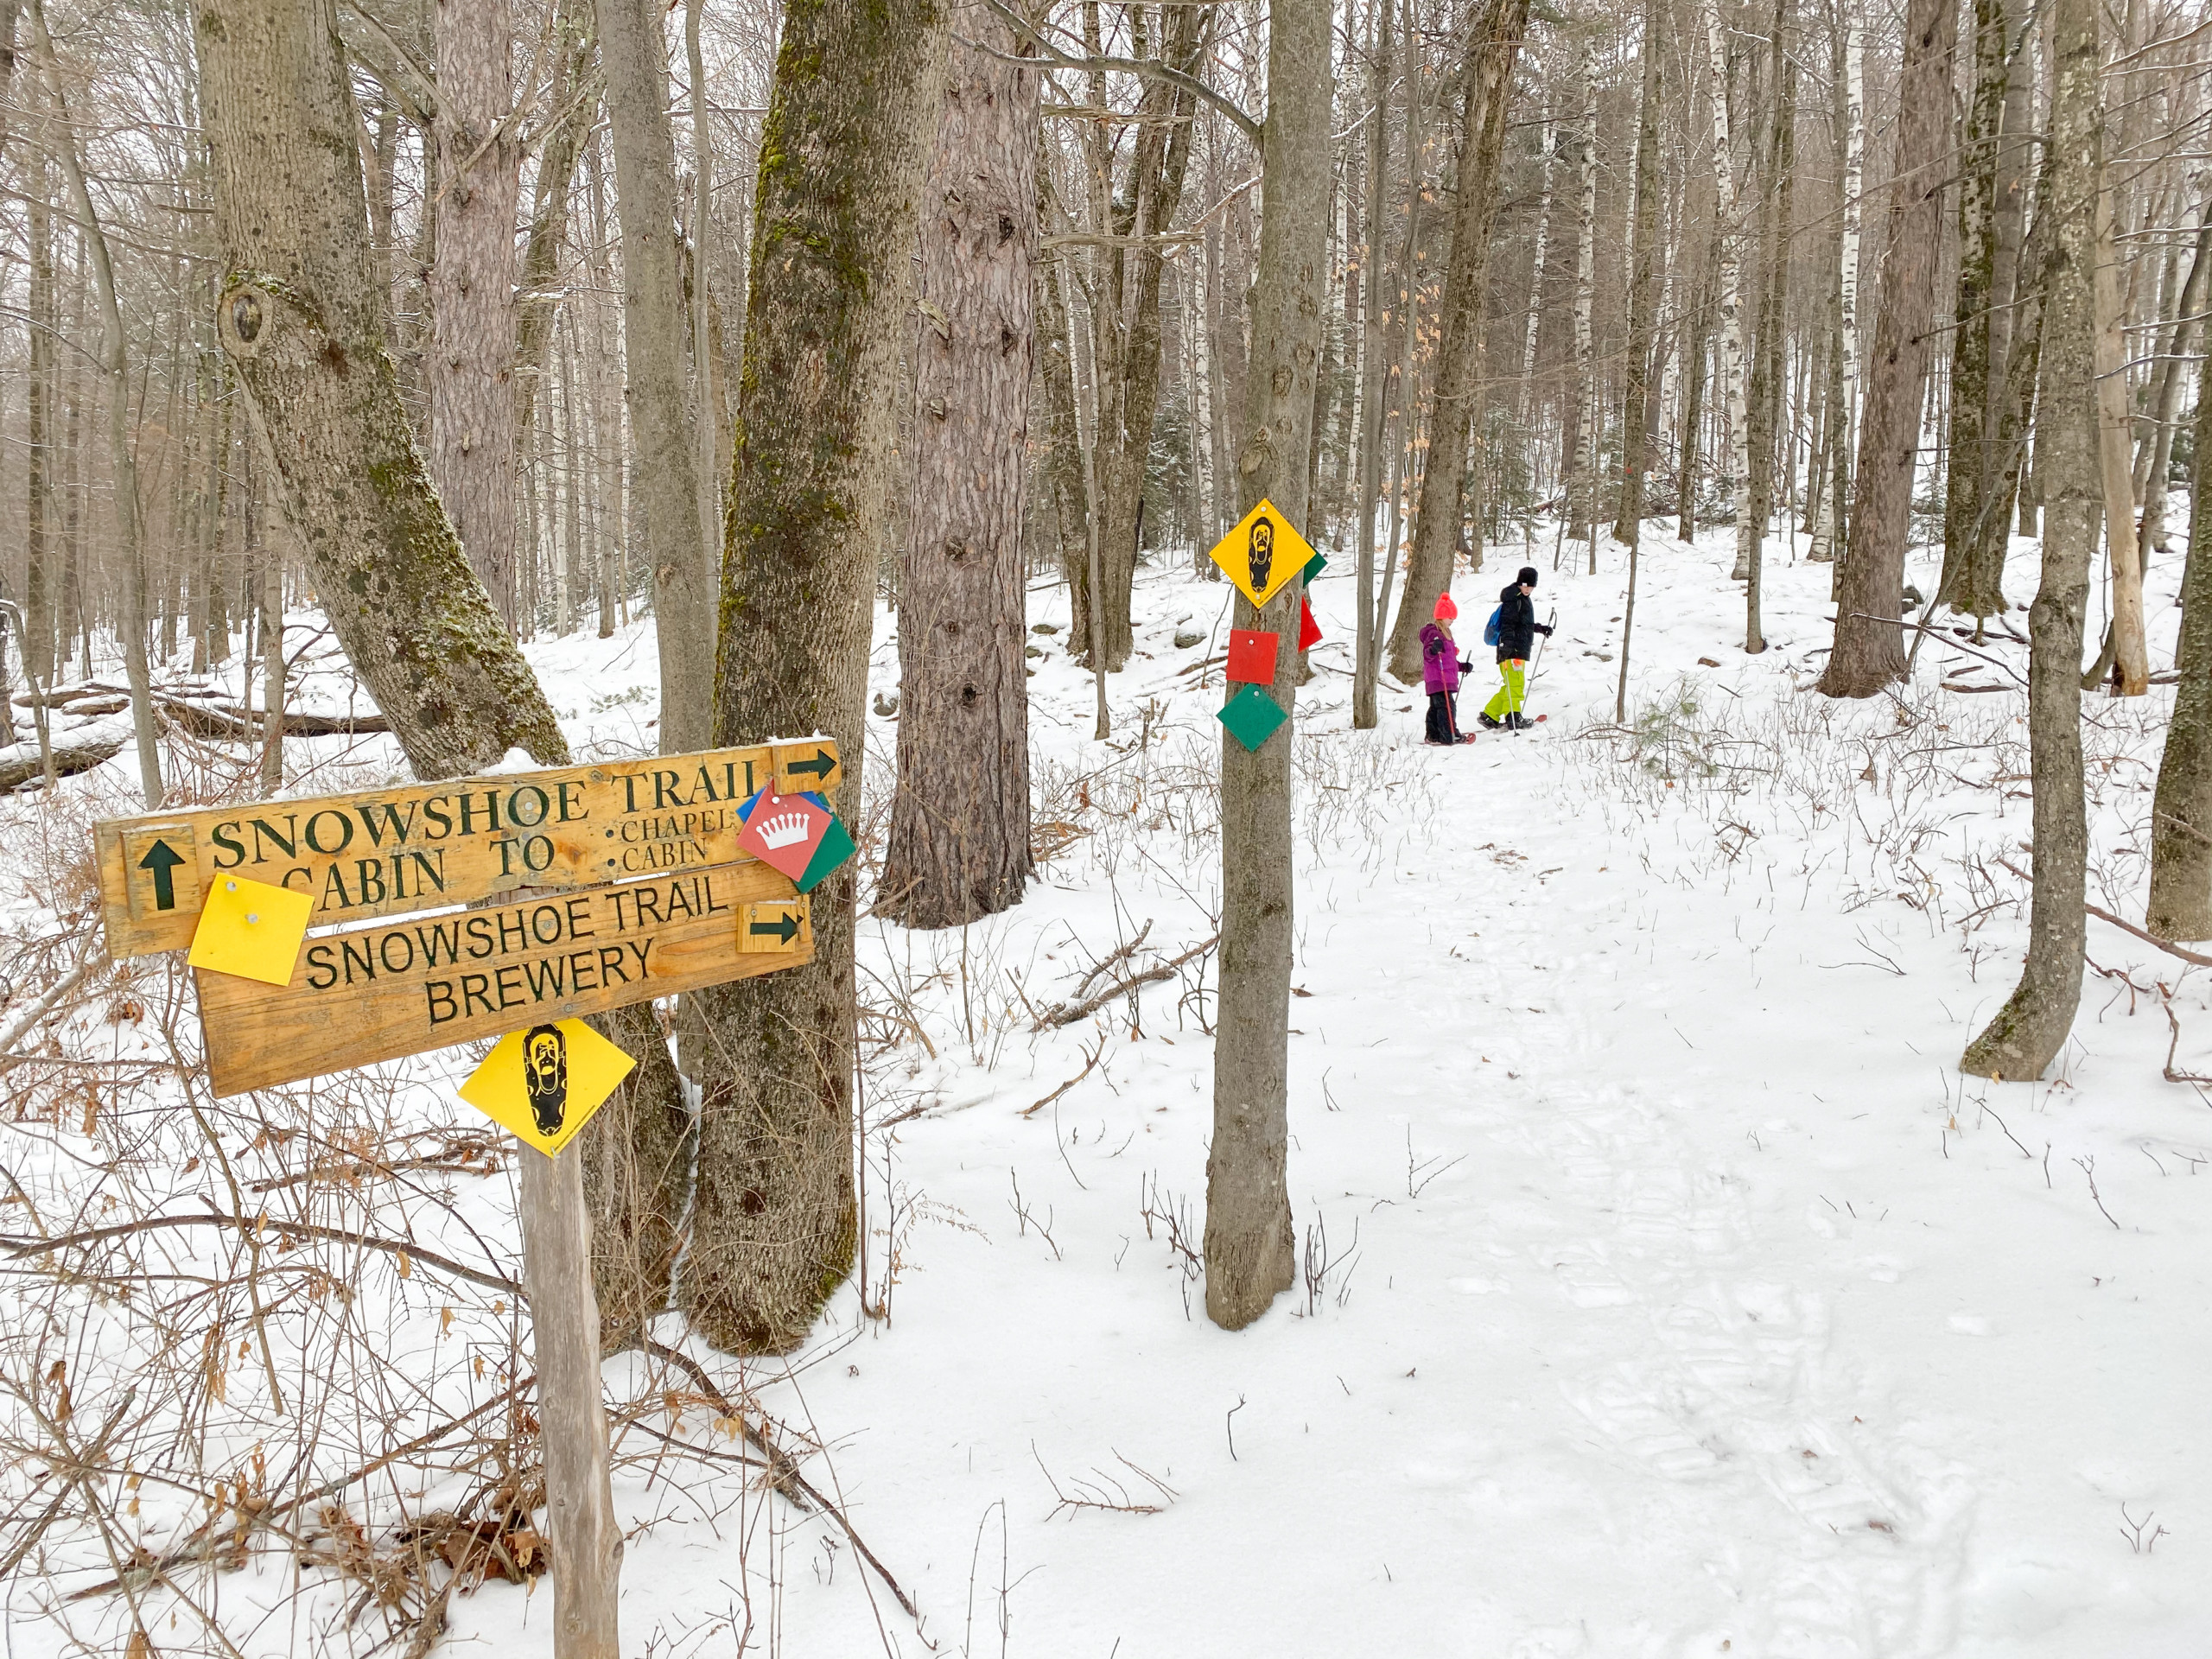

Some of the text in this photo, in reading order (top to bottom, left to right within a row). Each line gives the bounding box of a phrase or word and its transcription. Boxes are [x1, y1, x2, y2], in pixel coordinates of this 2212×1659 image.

[212, 779, 590, 870] SNOWSHOE
[488, 835, 555, 877] TO
[620, 808, 734, 843] CHAPEL
[622, 836, 709, 872] CABIN
[306, 875, 729, 991] SNOWSHOE TRAIL
[424, 937, 655, 1027] BREWERY
